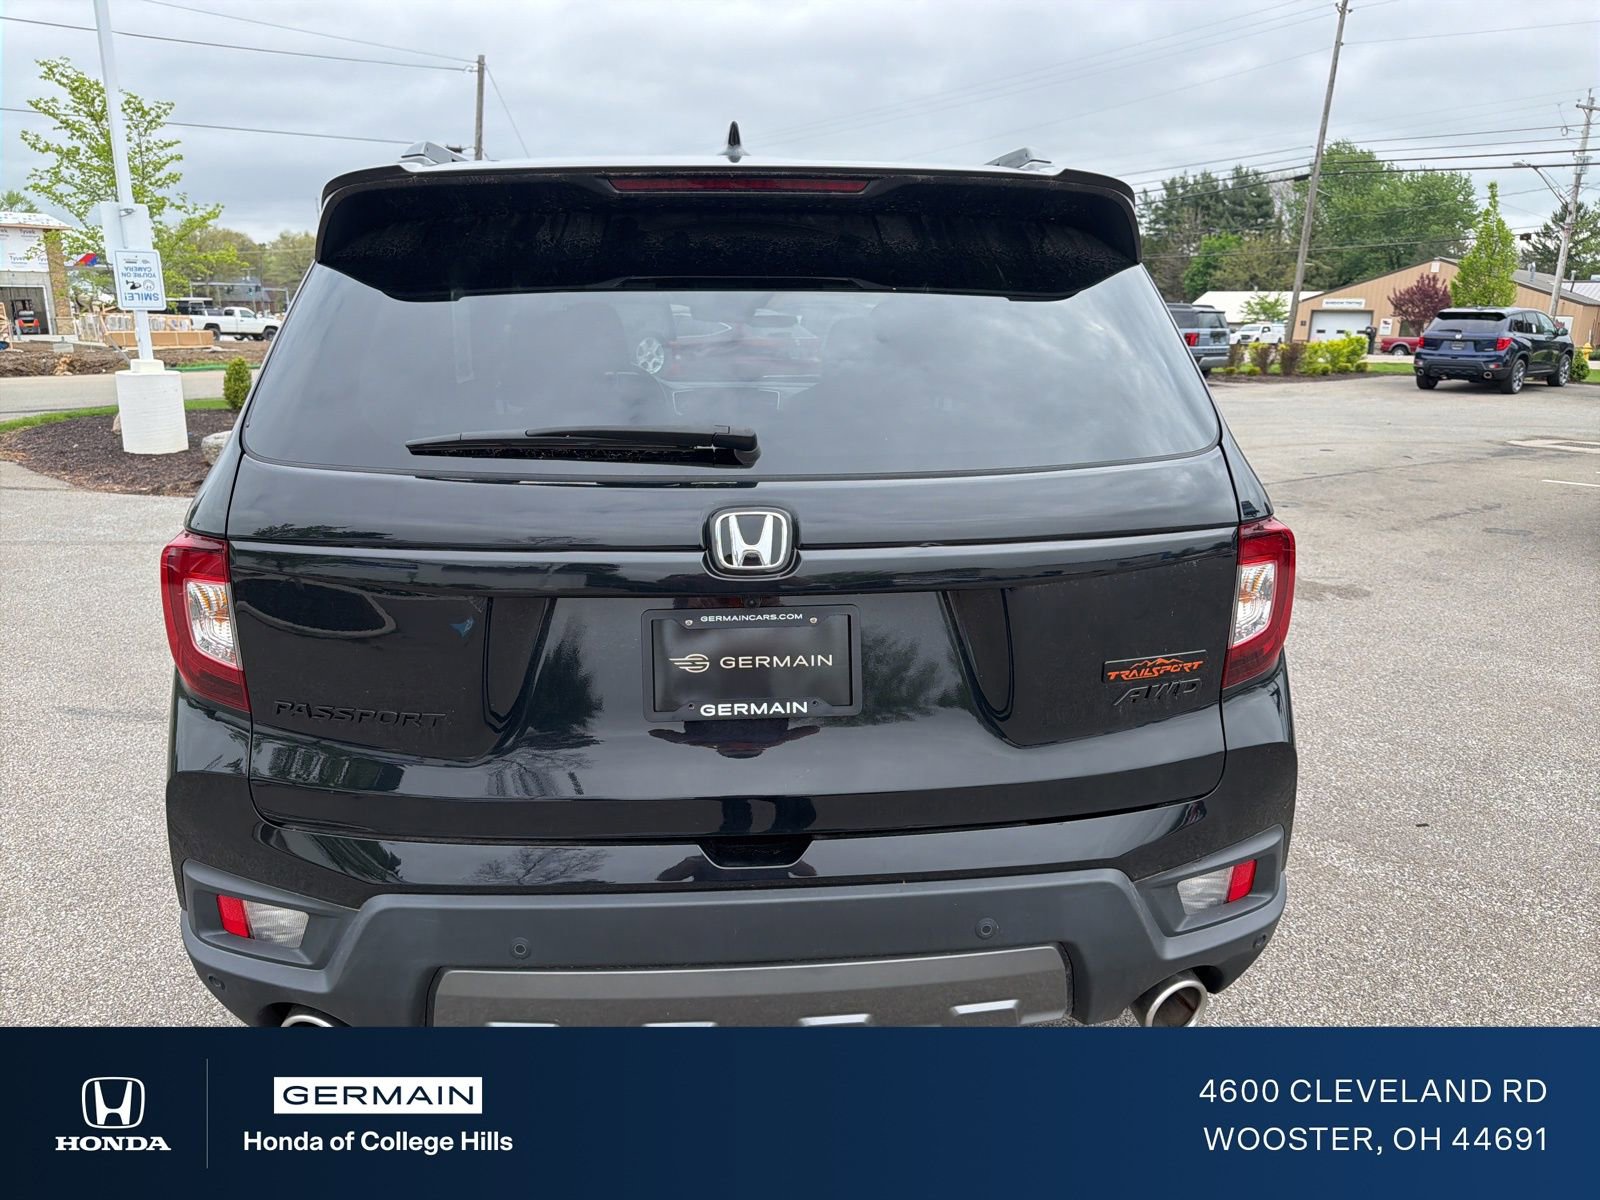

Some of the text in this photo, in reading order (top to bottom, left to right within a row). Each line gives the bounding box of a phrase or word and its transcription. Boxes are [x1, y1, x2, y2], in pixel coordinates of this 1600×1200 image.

[124, 292, 160, 301] SMILE!
[700, 613, 803, 623] GERMAINCARS.COM
[719, 654, 833, 669] GERMAIN
[1107, 660, 1204, 681] TRAILSPORT
[1113, 678, 1200, 706] AWD
[273, 700, 448, 728] PASSPORT
[699, 701, 808, 717] GERMAIN
